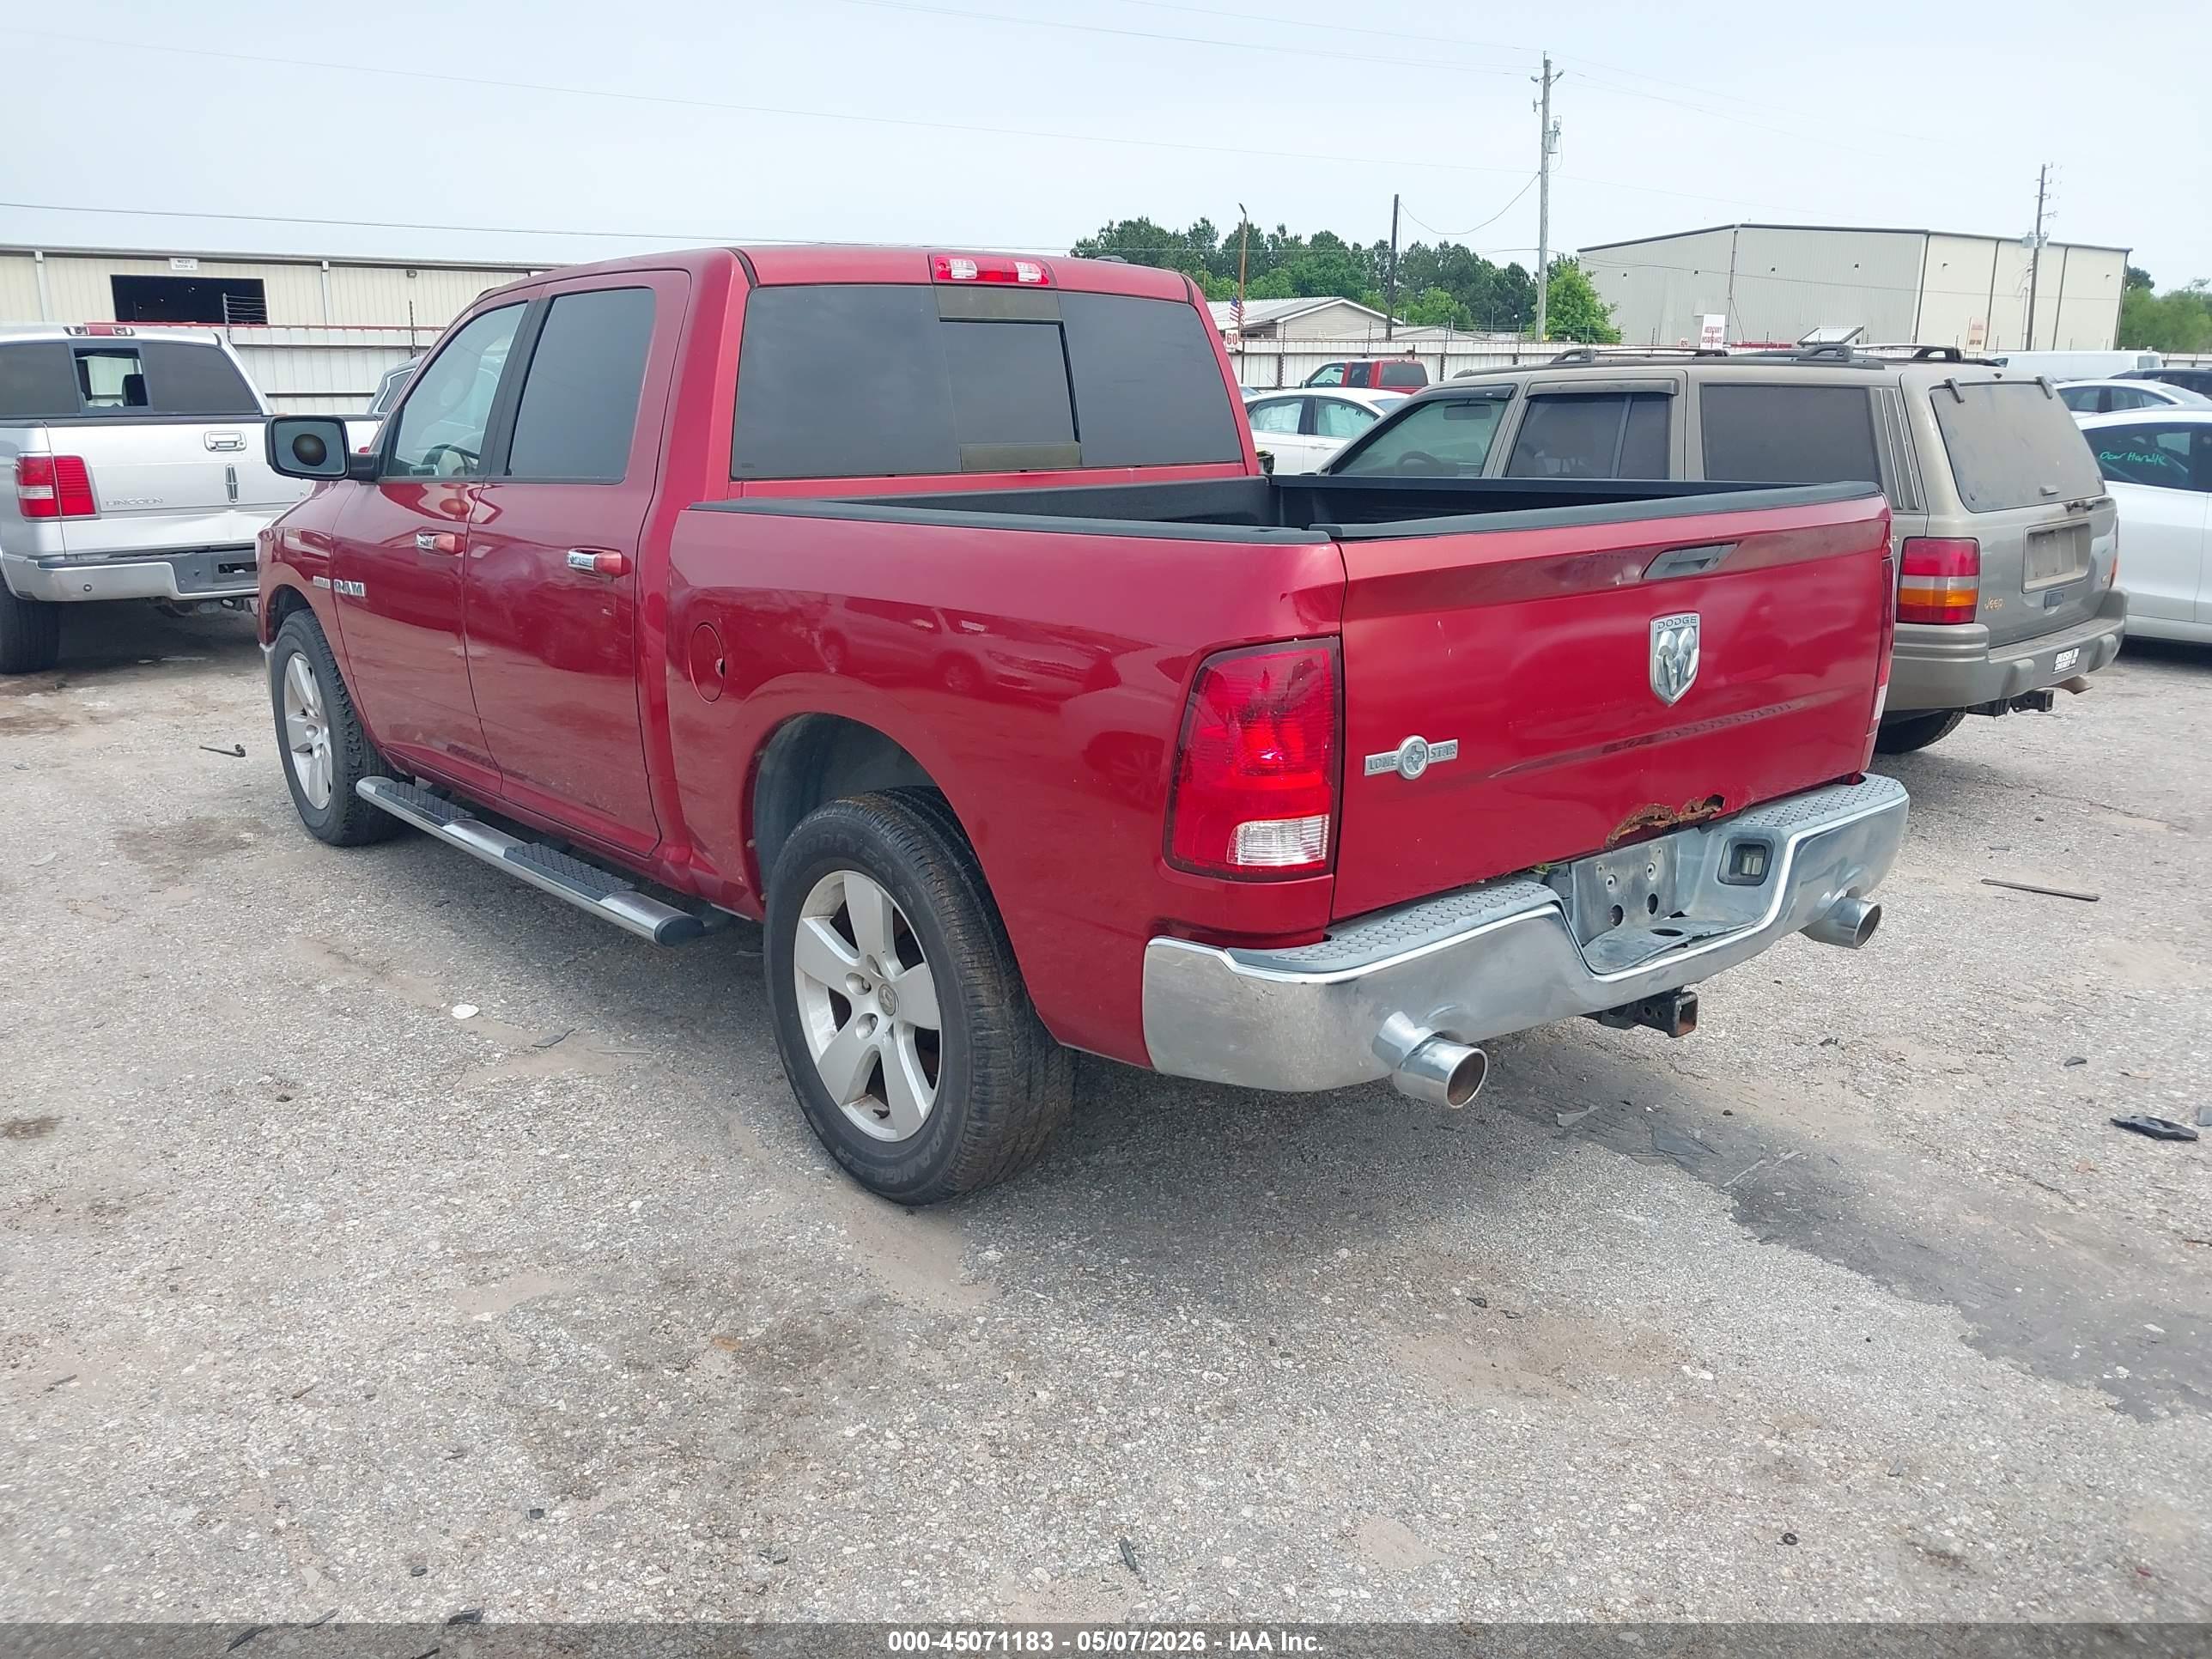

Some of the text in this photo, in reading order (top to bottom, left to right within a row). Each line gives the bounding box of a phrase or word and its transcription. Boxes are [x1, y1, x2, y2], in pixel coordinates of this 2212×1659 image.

[1227, 332, 1238, 344] 60
[106, 497, 163, 506] LINCOLN
[333, 579, 365, 597] RAM
[1657, 616, 1698, 629] DODGE
[1369, 744, 1456, 770] LONE STAR
